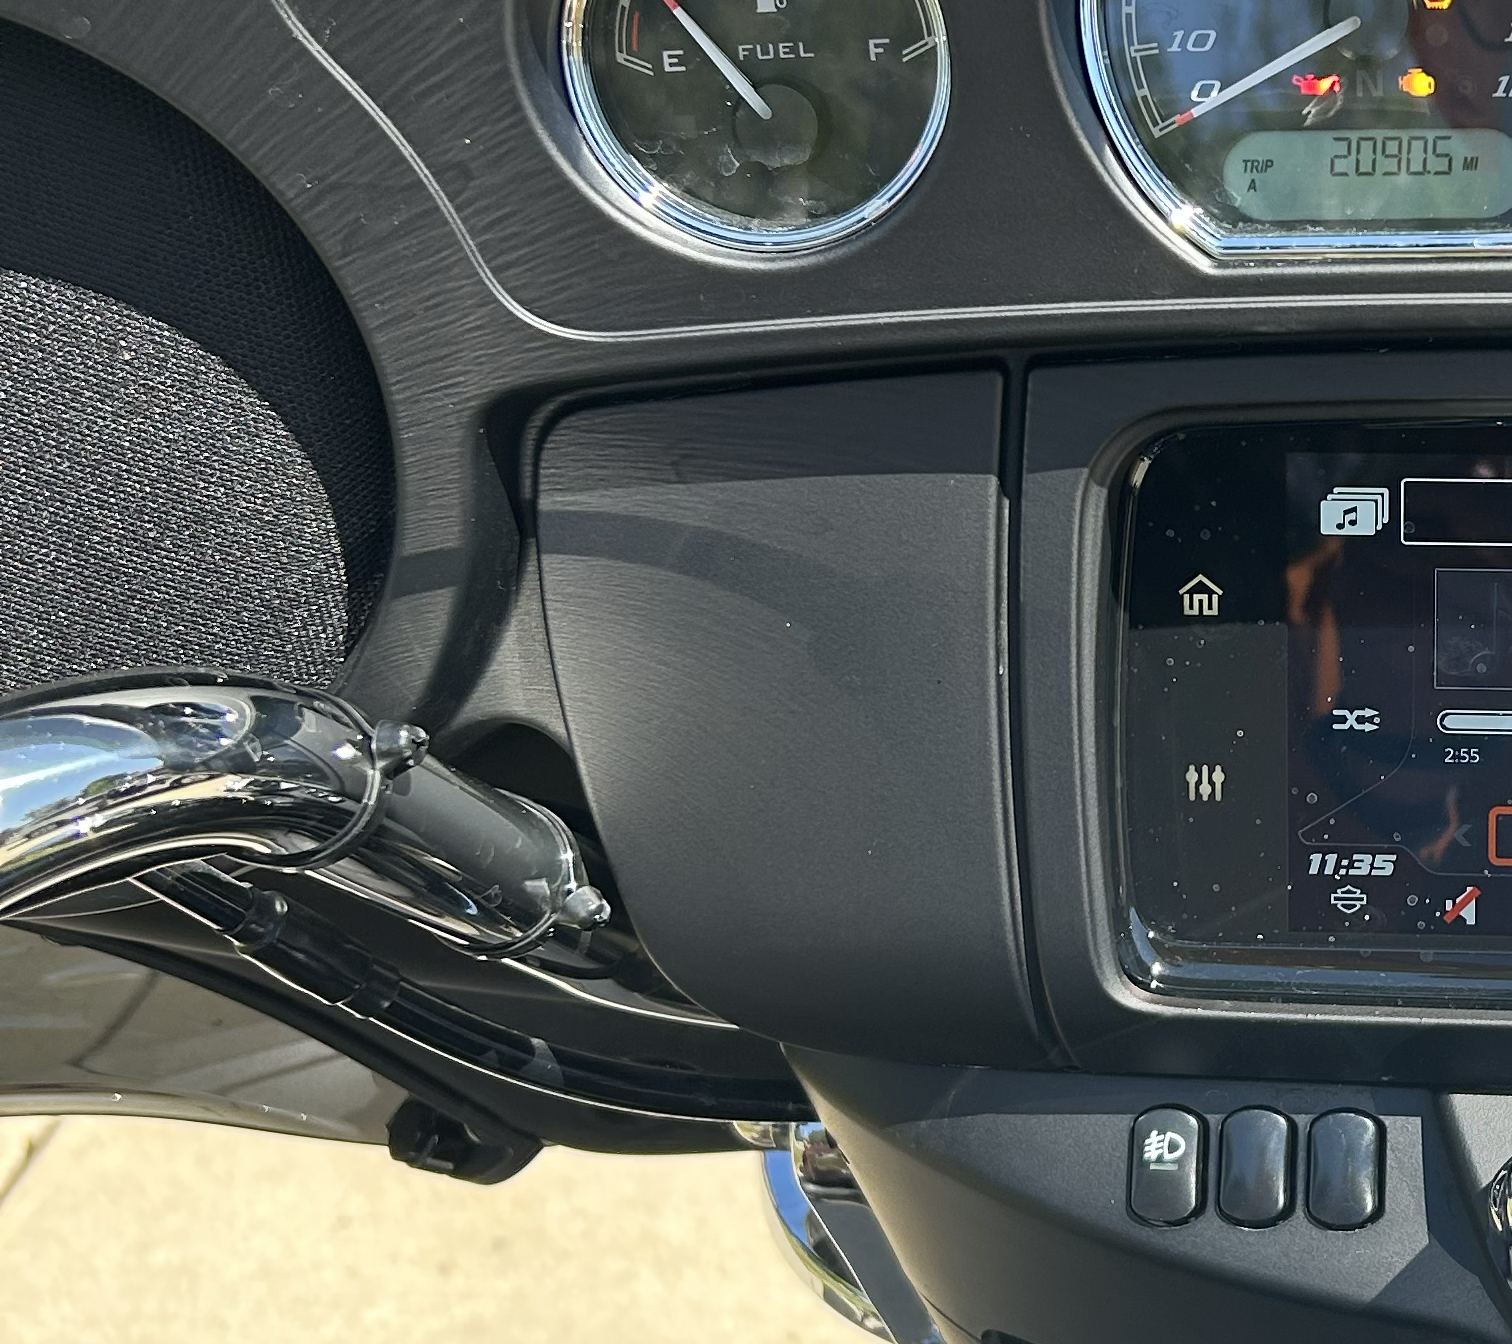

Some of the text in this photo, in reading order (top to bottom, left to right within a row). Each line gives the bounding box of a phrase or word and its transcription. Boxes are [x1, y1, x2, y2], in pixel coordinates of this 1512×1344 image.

[738, 42, 815, 61] FUEL
[868, 38, 890, 61] F
[1167, 30, 1217, 53] 10
[662, 50, 687, 73] E
[1190, 80, 1222, 103] 0
[1242, 159, 1274, 174] TRIP
[1462, 156, 1479, 171] MI
[1246, 178, 1257, 193] A
[1444, 748, 1480, 764] 2:55
[1308, 854, 1397, 876] 11:35
